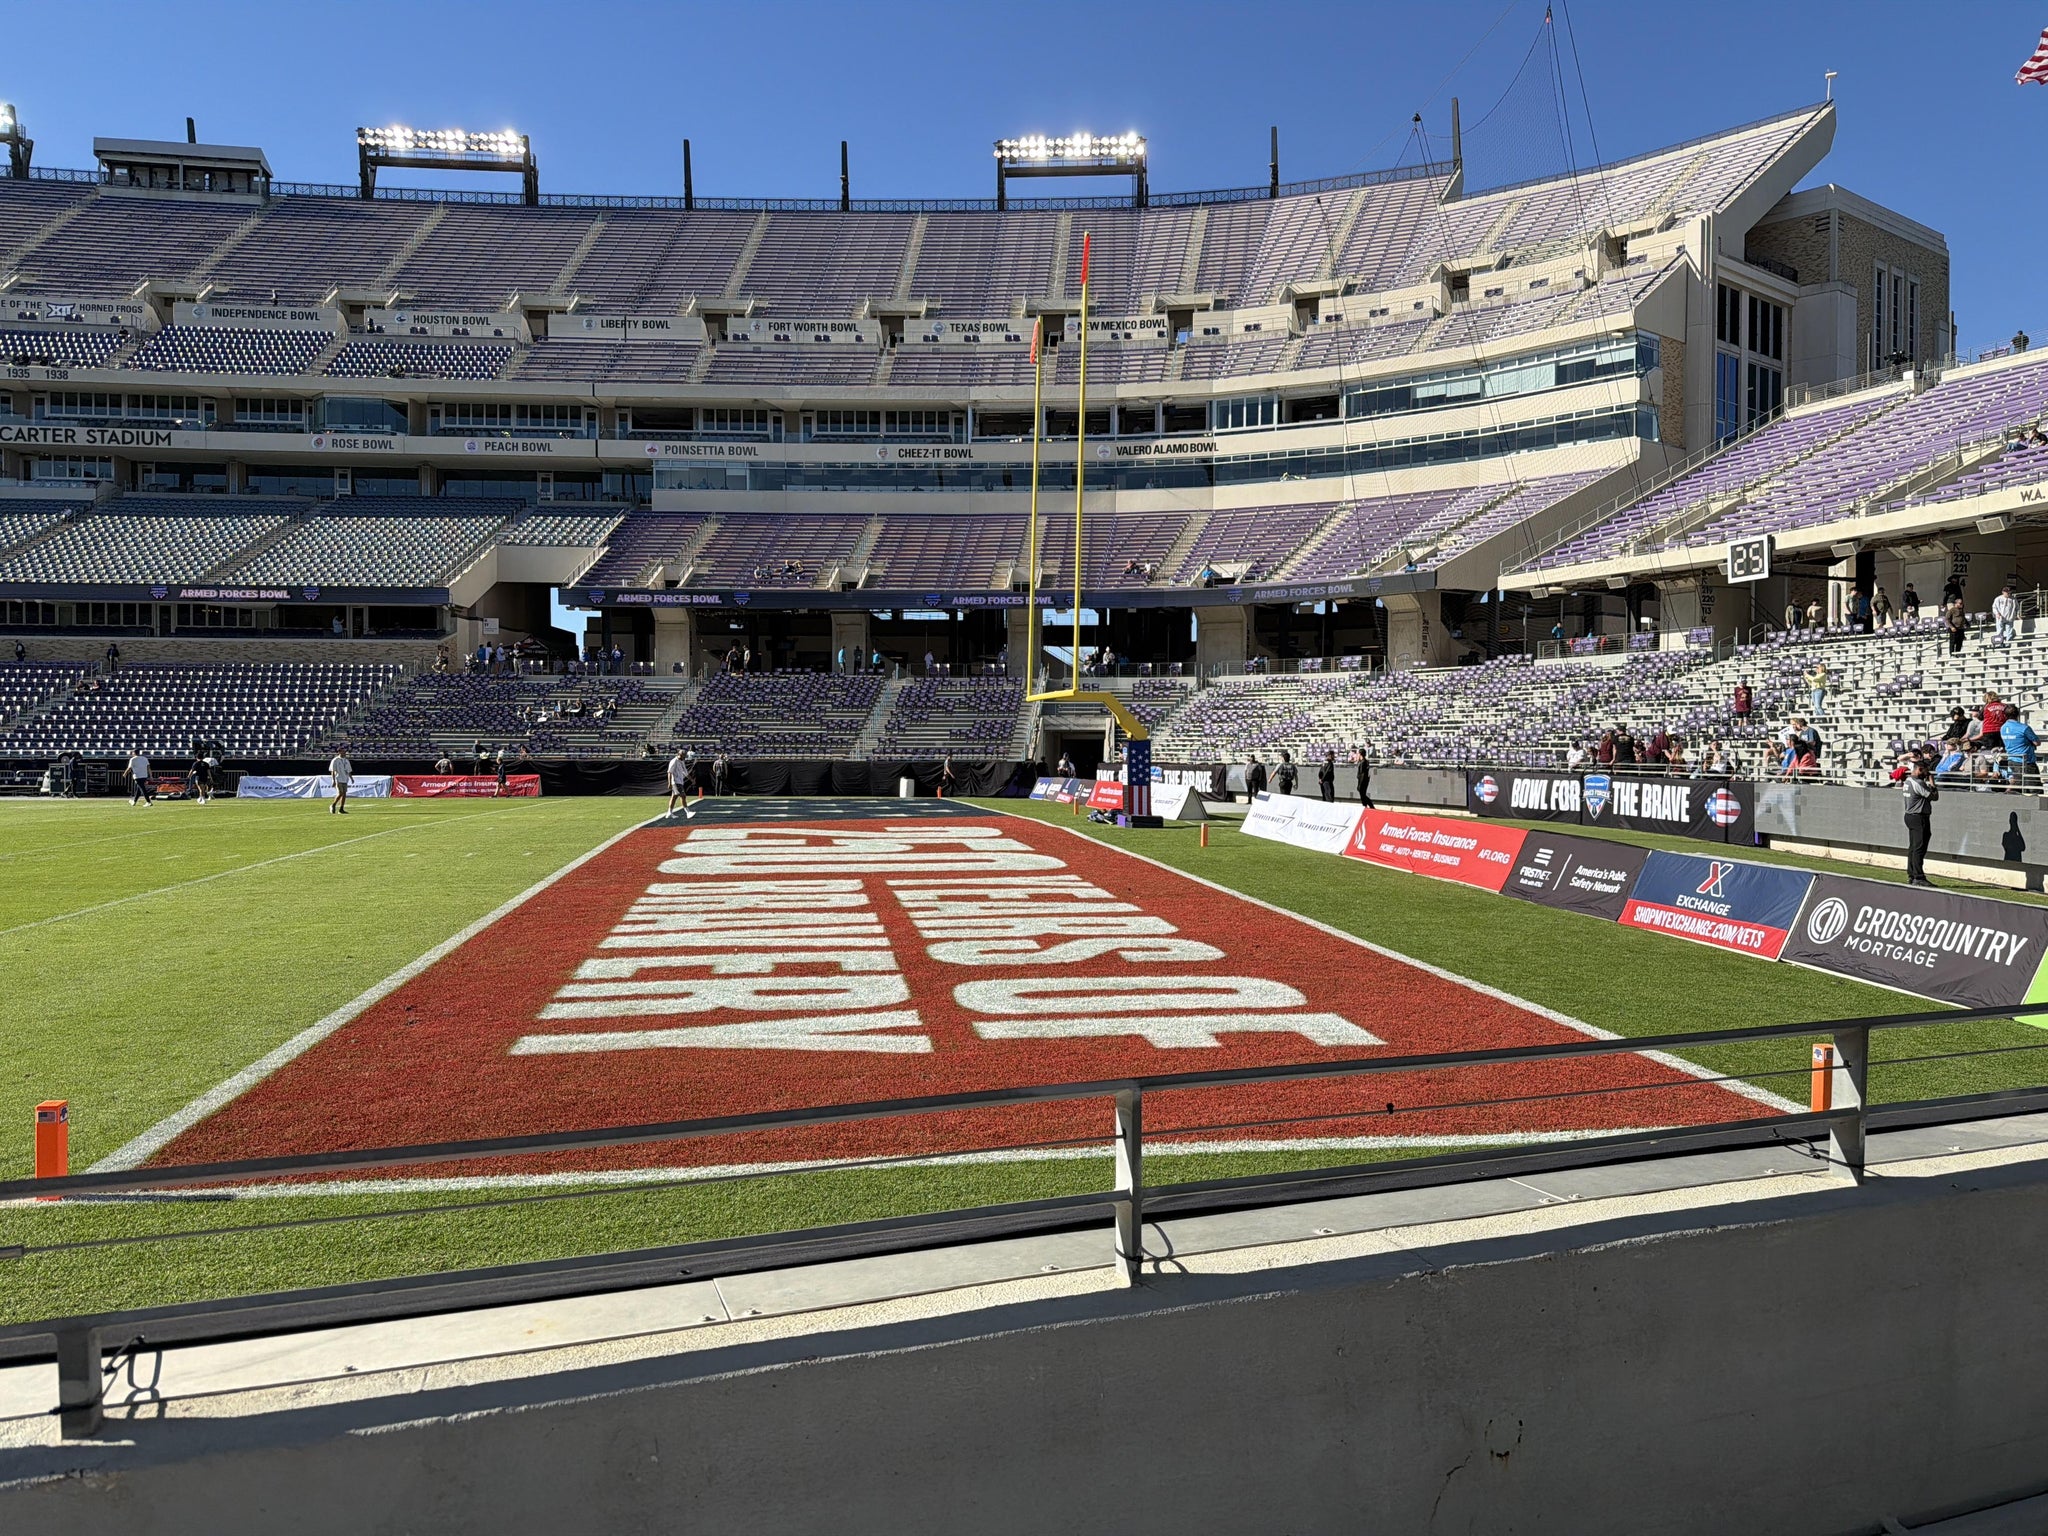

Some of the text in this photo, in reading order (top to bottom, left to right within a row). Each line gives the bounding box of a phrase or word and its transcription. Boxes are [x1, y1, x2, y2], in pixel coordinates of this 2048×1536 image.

[10, 300, 22, 308] OF
[24, 301, 42, 309] THE
[79, 304, 114, 313] HORNED
[116, 305, 143, 314] FROGS
[211, 307, 321, 321] INDEPENDENCE BOWL
[413, 314, 491, 326] HOUSTON BOWL
[601, 319, 671, 330] LIBERTY BOWL
[768, 321, 859, 333] FORT WORTH BOWL
[1101, 319, 1137, 331] MEXICO
[1139, 318, 1168, 329] BOWL
[949, 322, 1011, 333] TEXAS BOWL
[6, 368, 30, 378] 1935
[45, 369, 69, 380] 1938
[0, 426, 172, 446] CARTER STADIUM
[331, 438, 395, 450] ROSE BOWL
[484, 441, 553, 453] PEACH BOWL
[664, 445, 759, 457] POINSETTIA BOWL
[1116, 442, 1219, 457] VALERO ALAMO BOWL
[898, 448, 974, 459] CHEEZ-IT BOWL
[2021, 488, 2046, 502] W.A.
[1734, 543, 1763, 575] 25
[1953, 554, 1971, 563] 220
[1953, 564, 1968, 573] 221
[179, 588, 291, 600] ARMED FORCES BOWL
[1254, 584, 1355, 599] ARMED FORCES BOWL
[616, 594, 722, 604] ARMED FORCES BOWL
[952, 596, 987, 605] ARMED
[988, 596, 1024, 605] FORCES
[1511, 778, 1691, 823] BOWL FOR THE BRAVE
[1379, 822, 1407, 839] Armed
[1406, 827, 1433, 843] Forces
[1432, 830, 1478, 850] Insurance
[657, 826, 1068, 875] 250
[1379, 843, 1395, 853] HOME
[1395, 847, 1411, 857] AUTO
[1433, 853, 1461, 866] BUSINESS
[1575, 865, 1628, 882] America's Public
[1569, 877, 1621, 894] Safety Network
[1676, 894, 1731, 917] EXCHANGE
[1633, 905, 1766, 949] SHOPMYEXCHANGE.COM/VETS
[1853, 905, 2028, 966] CROSSCOUNTRY
[1844, 935, 1938, 968] MORTGAGE
[508, 878, 934, 1056] BRAVERY
[884, 874, 1388, 1049] YEARS OF
